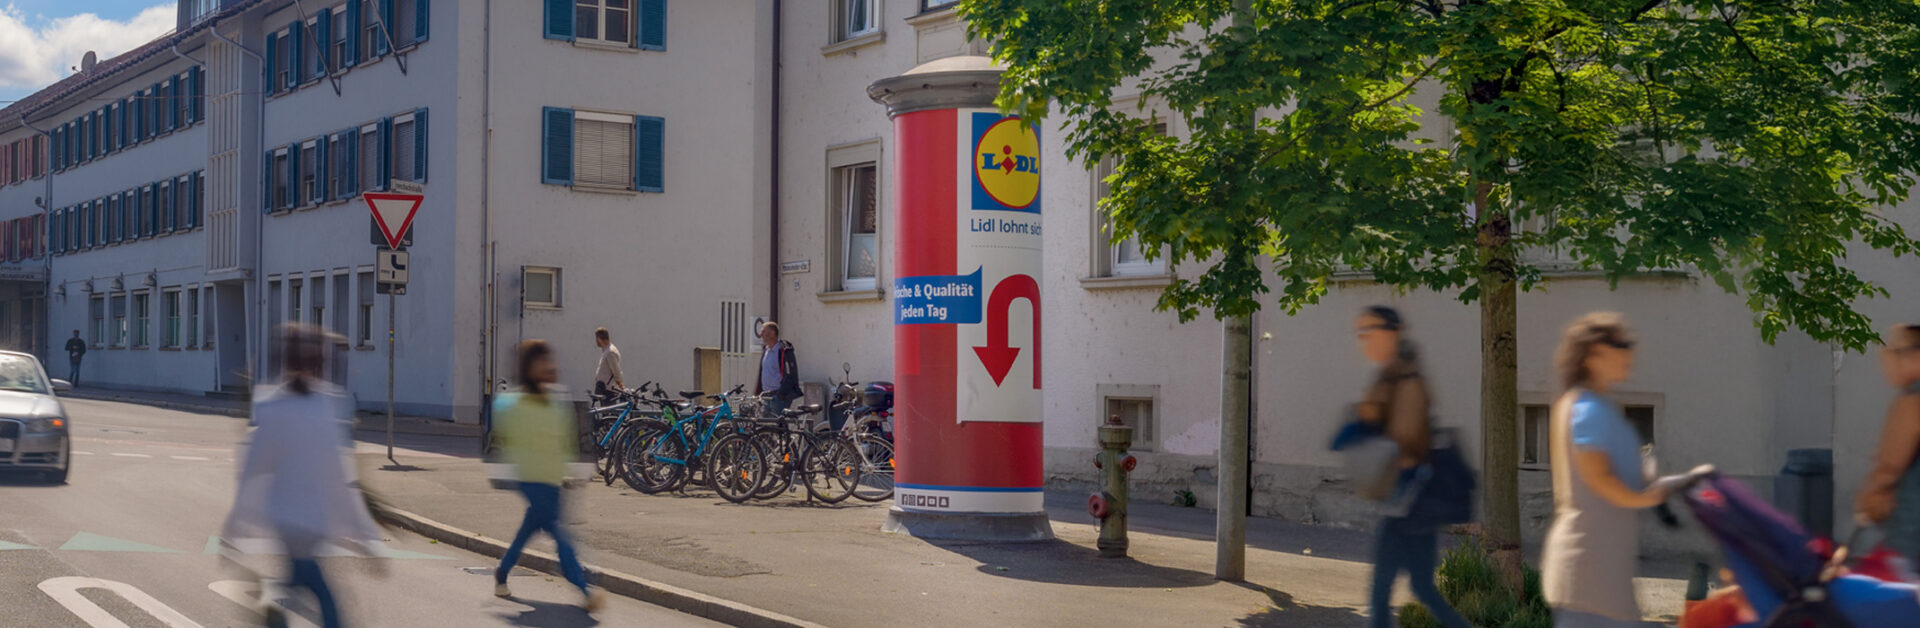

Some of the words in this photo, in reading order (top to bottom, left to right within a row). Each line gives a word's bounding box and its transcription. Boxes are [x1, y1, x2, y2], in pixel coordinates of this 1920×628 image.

[971, 218, 995, 232] Lidl
[1000, 219, 1029, 234] lohnt
[914, 284, 922, 297] &
[924, 283, 974, 300] Qualität
[901, 304, 924, 321] jeden
[926, 304, 948, 320] Tag
